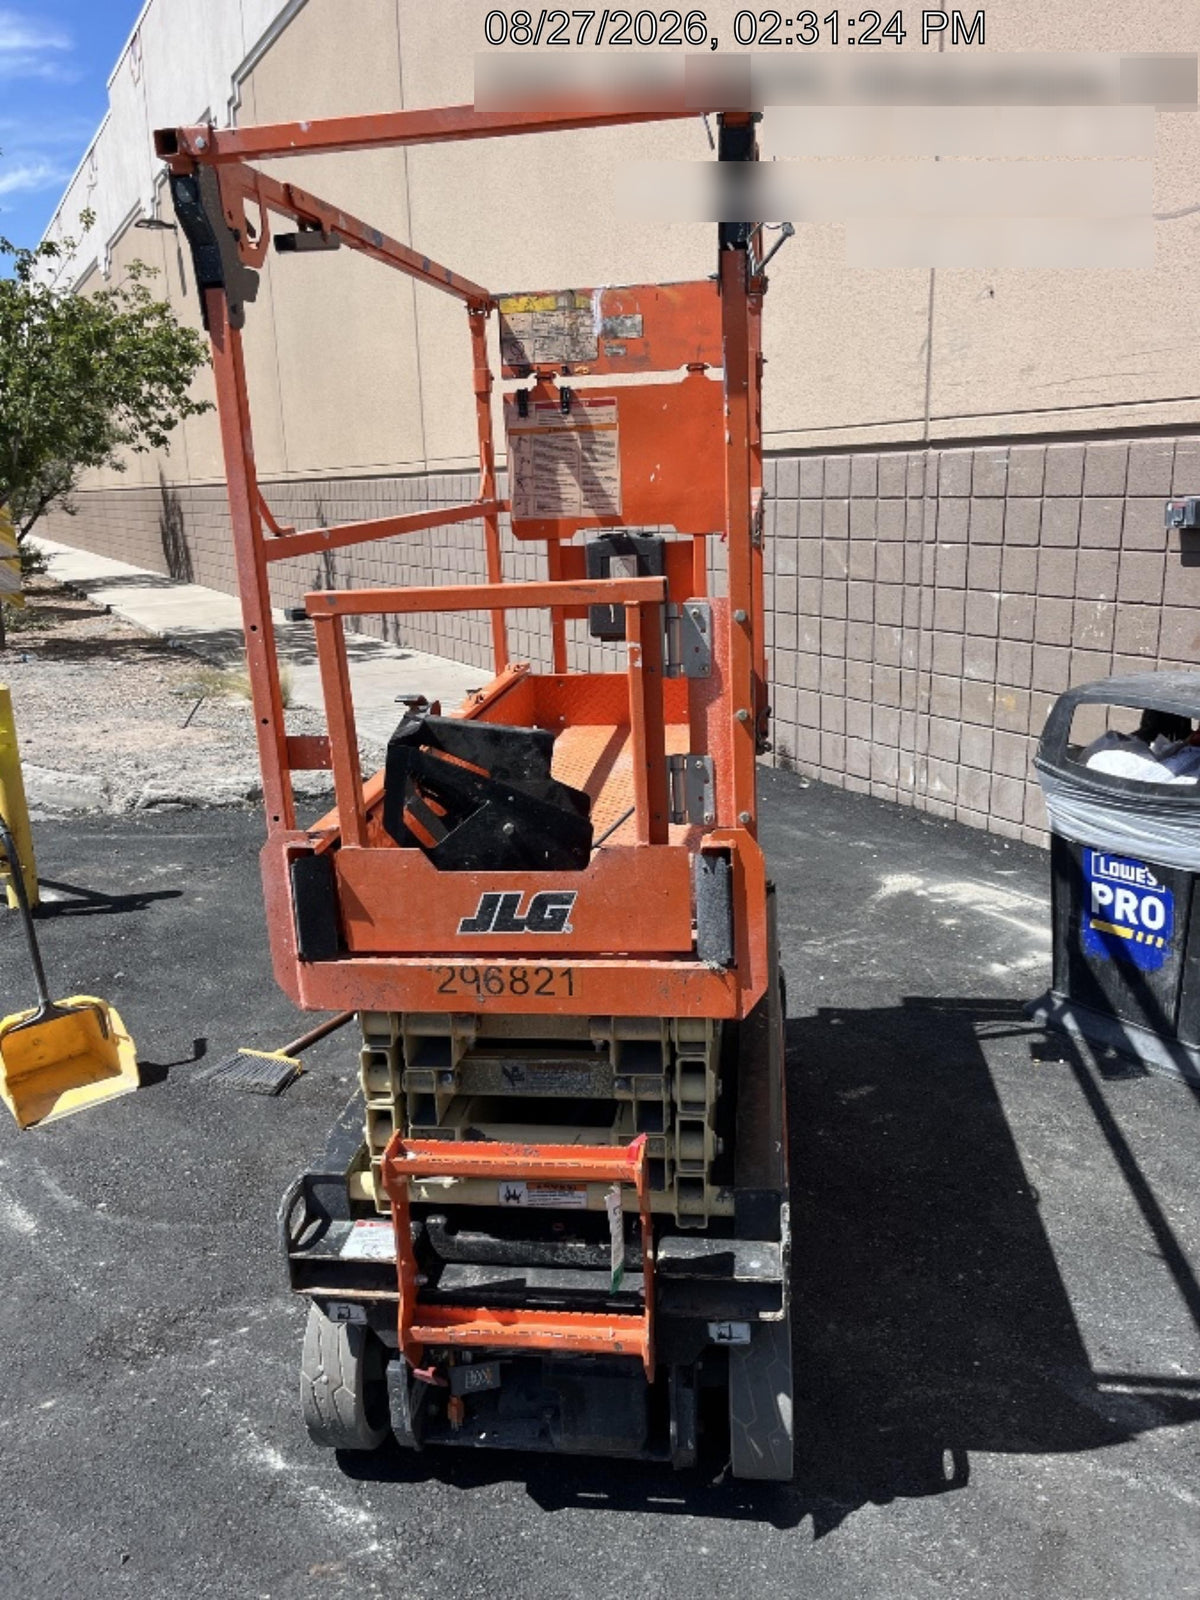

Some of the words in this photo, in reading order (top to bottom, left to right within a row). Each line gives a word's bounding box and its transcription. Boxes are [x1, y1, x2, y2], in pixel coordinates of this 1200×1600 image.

[1100, 856, 1158, 886] LOWE'S
[457, 890, 578, 935] JLG
[1091, 881, 1165, 930] PRO
[436, 965, 574, 997] 296821
